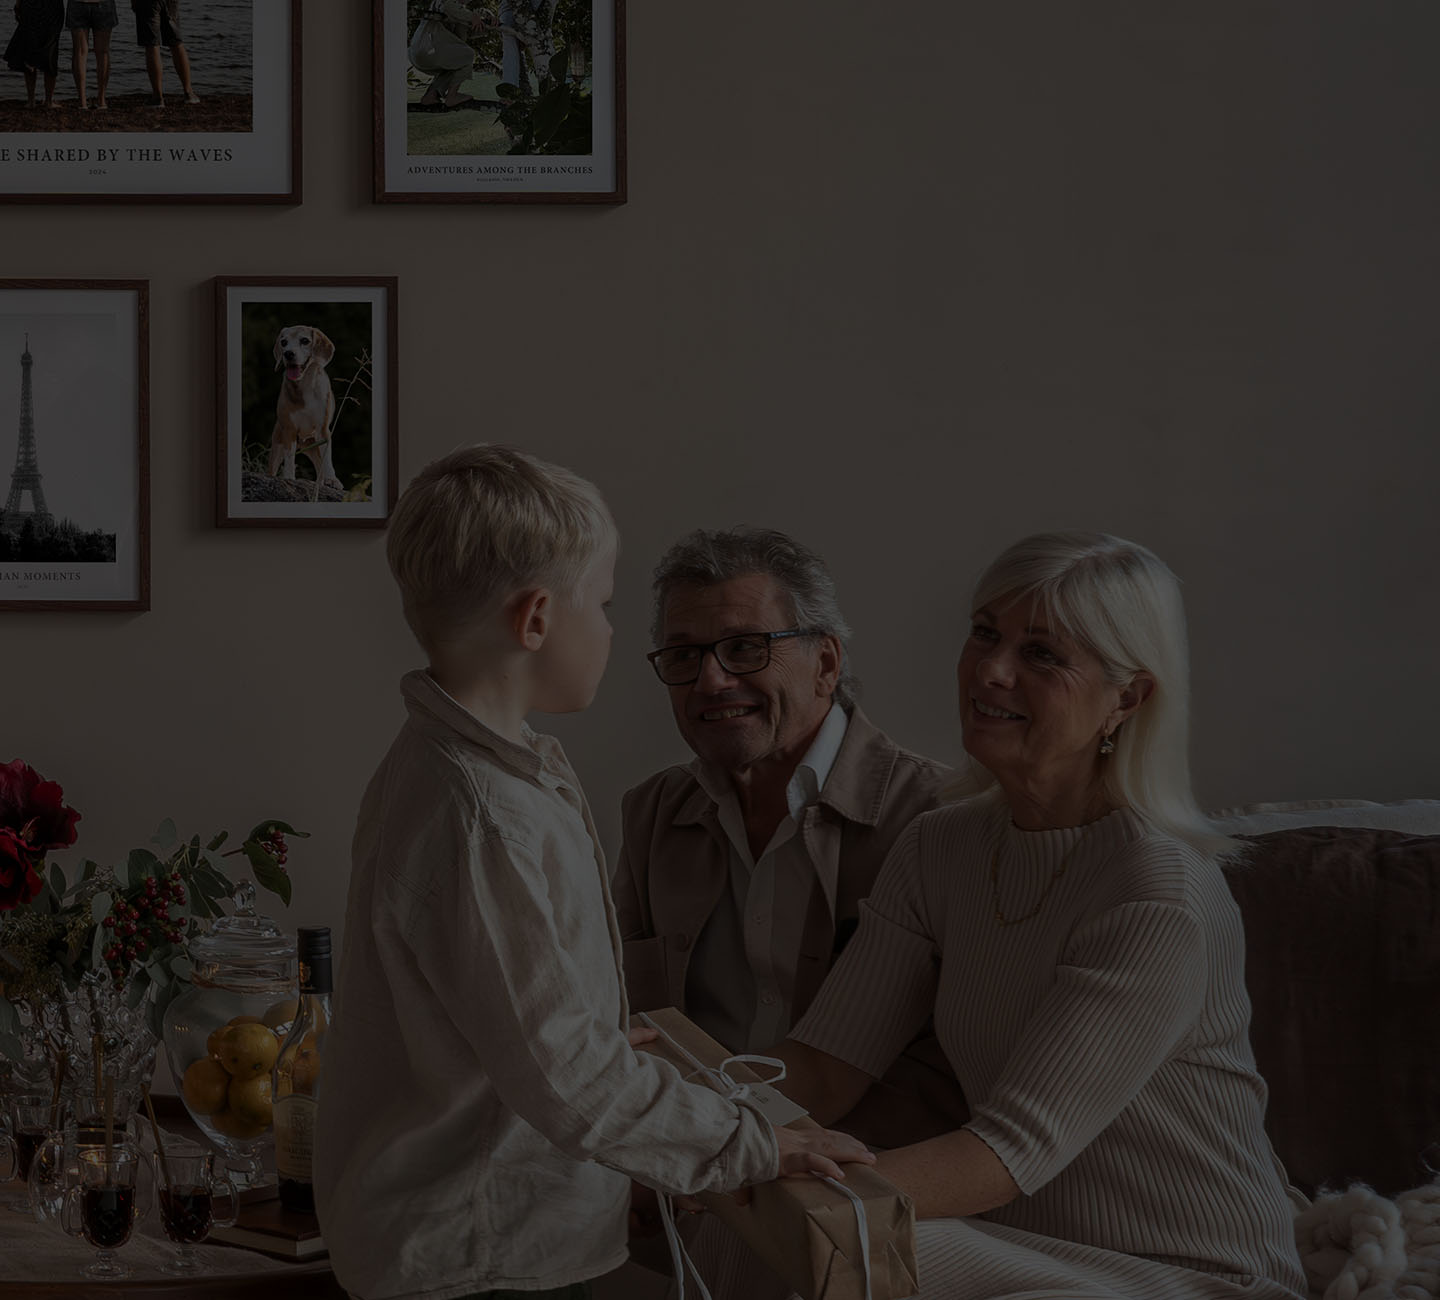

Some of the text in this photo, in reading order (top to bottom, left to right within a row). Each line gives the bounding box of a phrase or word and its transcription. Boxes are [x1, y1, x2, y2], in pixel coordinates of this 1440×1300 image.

[16, 148, 90, 162] SHARED
[96, 148, 121, 162] BY
[125, 148, 163, 162] THE
[169, 148, 233, 162] WAVES
[407, 165, 593, 175] ADVENTURES AMONG THE BRANCHES
[23, 571, 81, 582] MOMENTS
